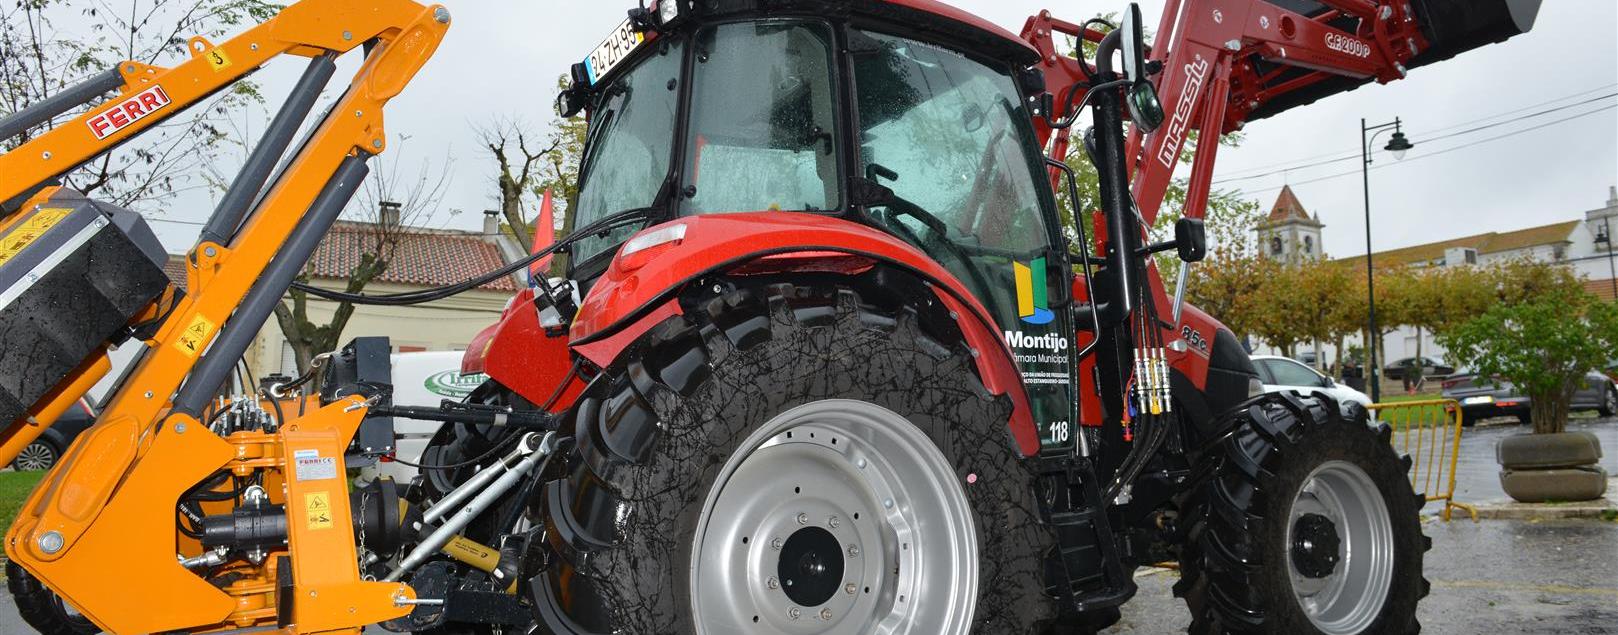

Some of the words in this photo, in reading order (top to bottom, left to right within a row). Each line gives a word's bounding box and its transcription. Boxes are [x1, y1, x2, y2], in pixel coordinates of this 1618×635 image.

[89, 87, 168, 137] FERRI
[1005, 330, 1068, 353] Montijo
[1013, 352, 1037, 363] âmara
[1038, 353, 1069, 365] Municipal
[1050, 421, 1068, 442] 118
